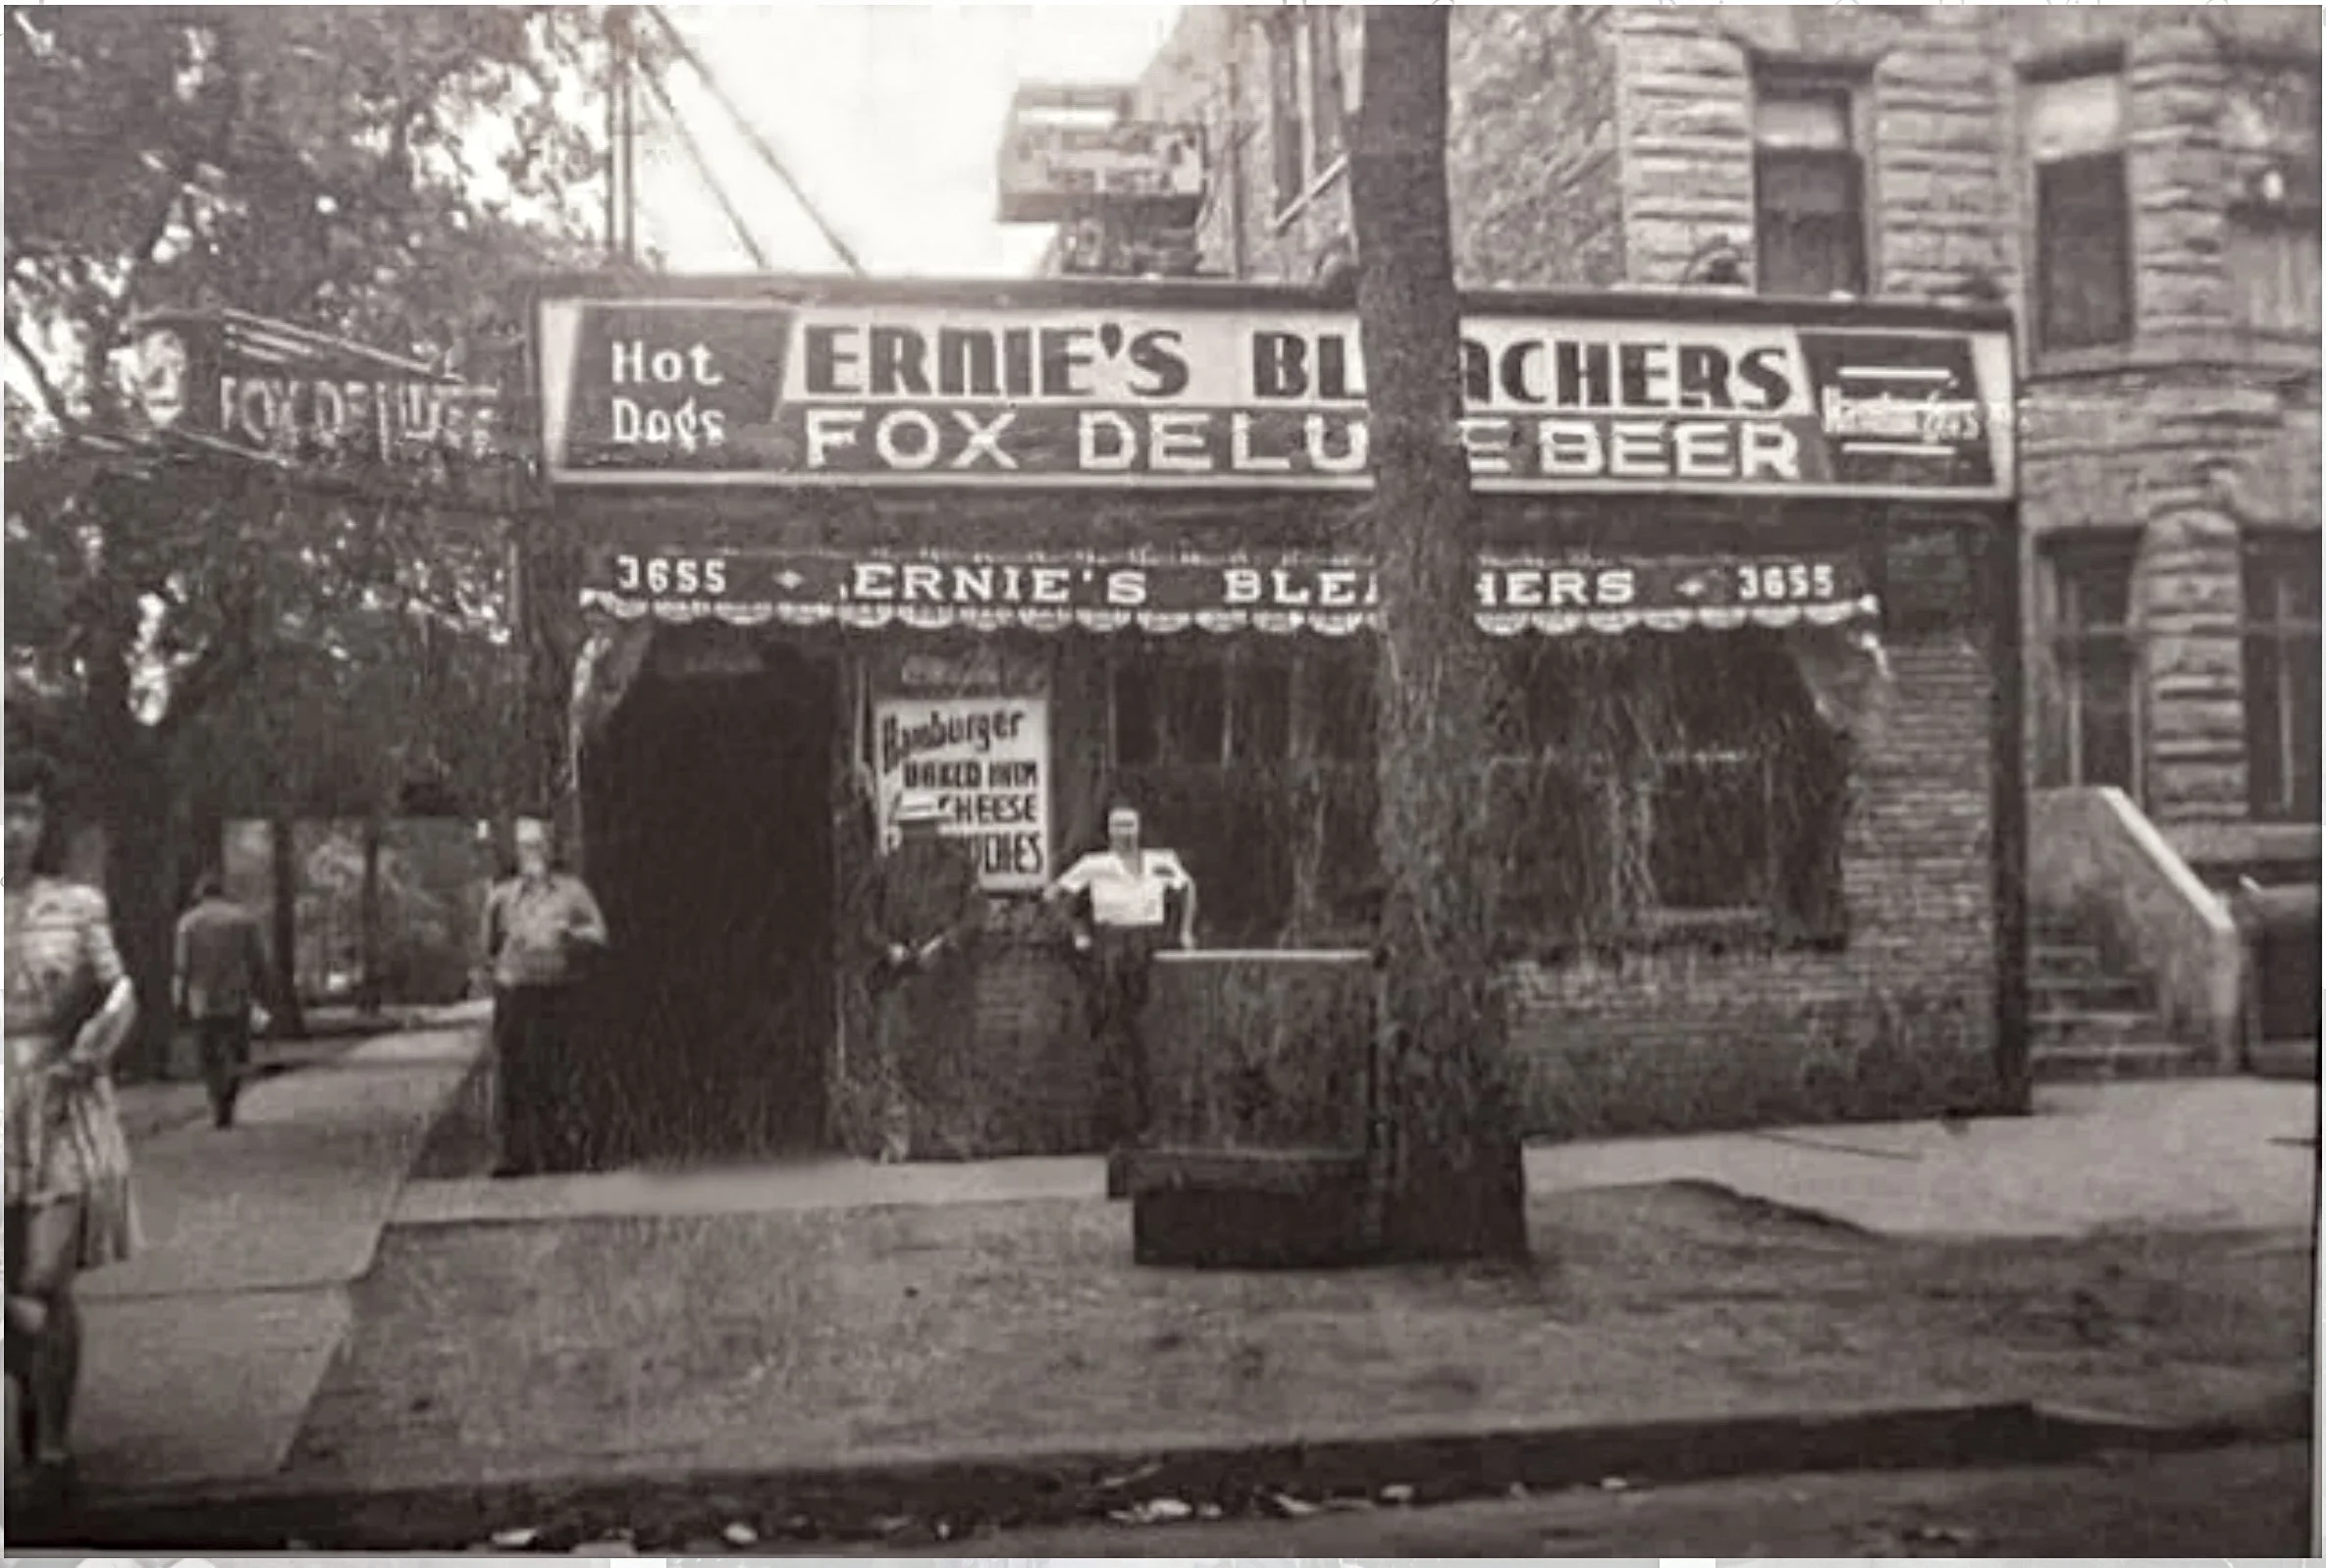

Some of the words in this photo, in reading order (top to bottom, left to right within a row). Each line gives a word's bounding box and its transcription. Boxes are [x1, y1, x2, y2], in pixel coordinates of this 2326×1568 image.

[611, 340, 724, 387] Hot
[803, 322, 1189, 397] ERNIE'S
[611, 394, 726, 453] Dogs
[805, 408, 1019, 470] FOX
[1079, 411, 1513, 475] DELUE
[1538, 419, 1803, 480] BEER
[616, 554, 726, 593] 3655
[853, 562, 1147, 604] ERNIE'S
[1737, 564, 1833, 600] 3655
